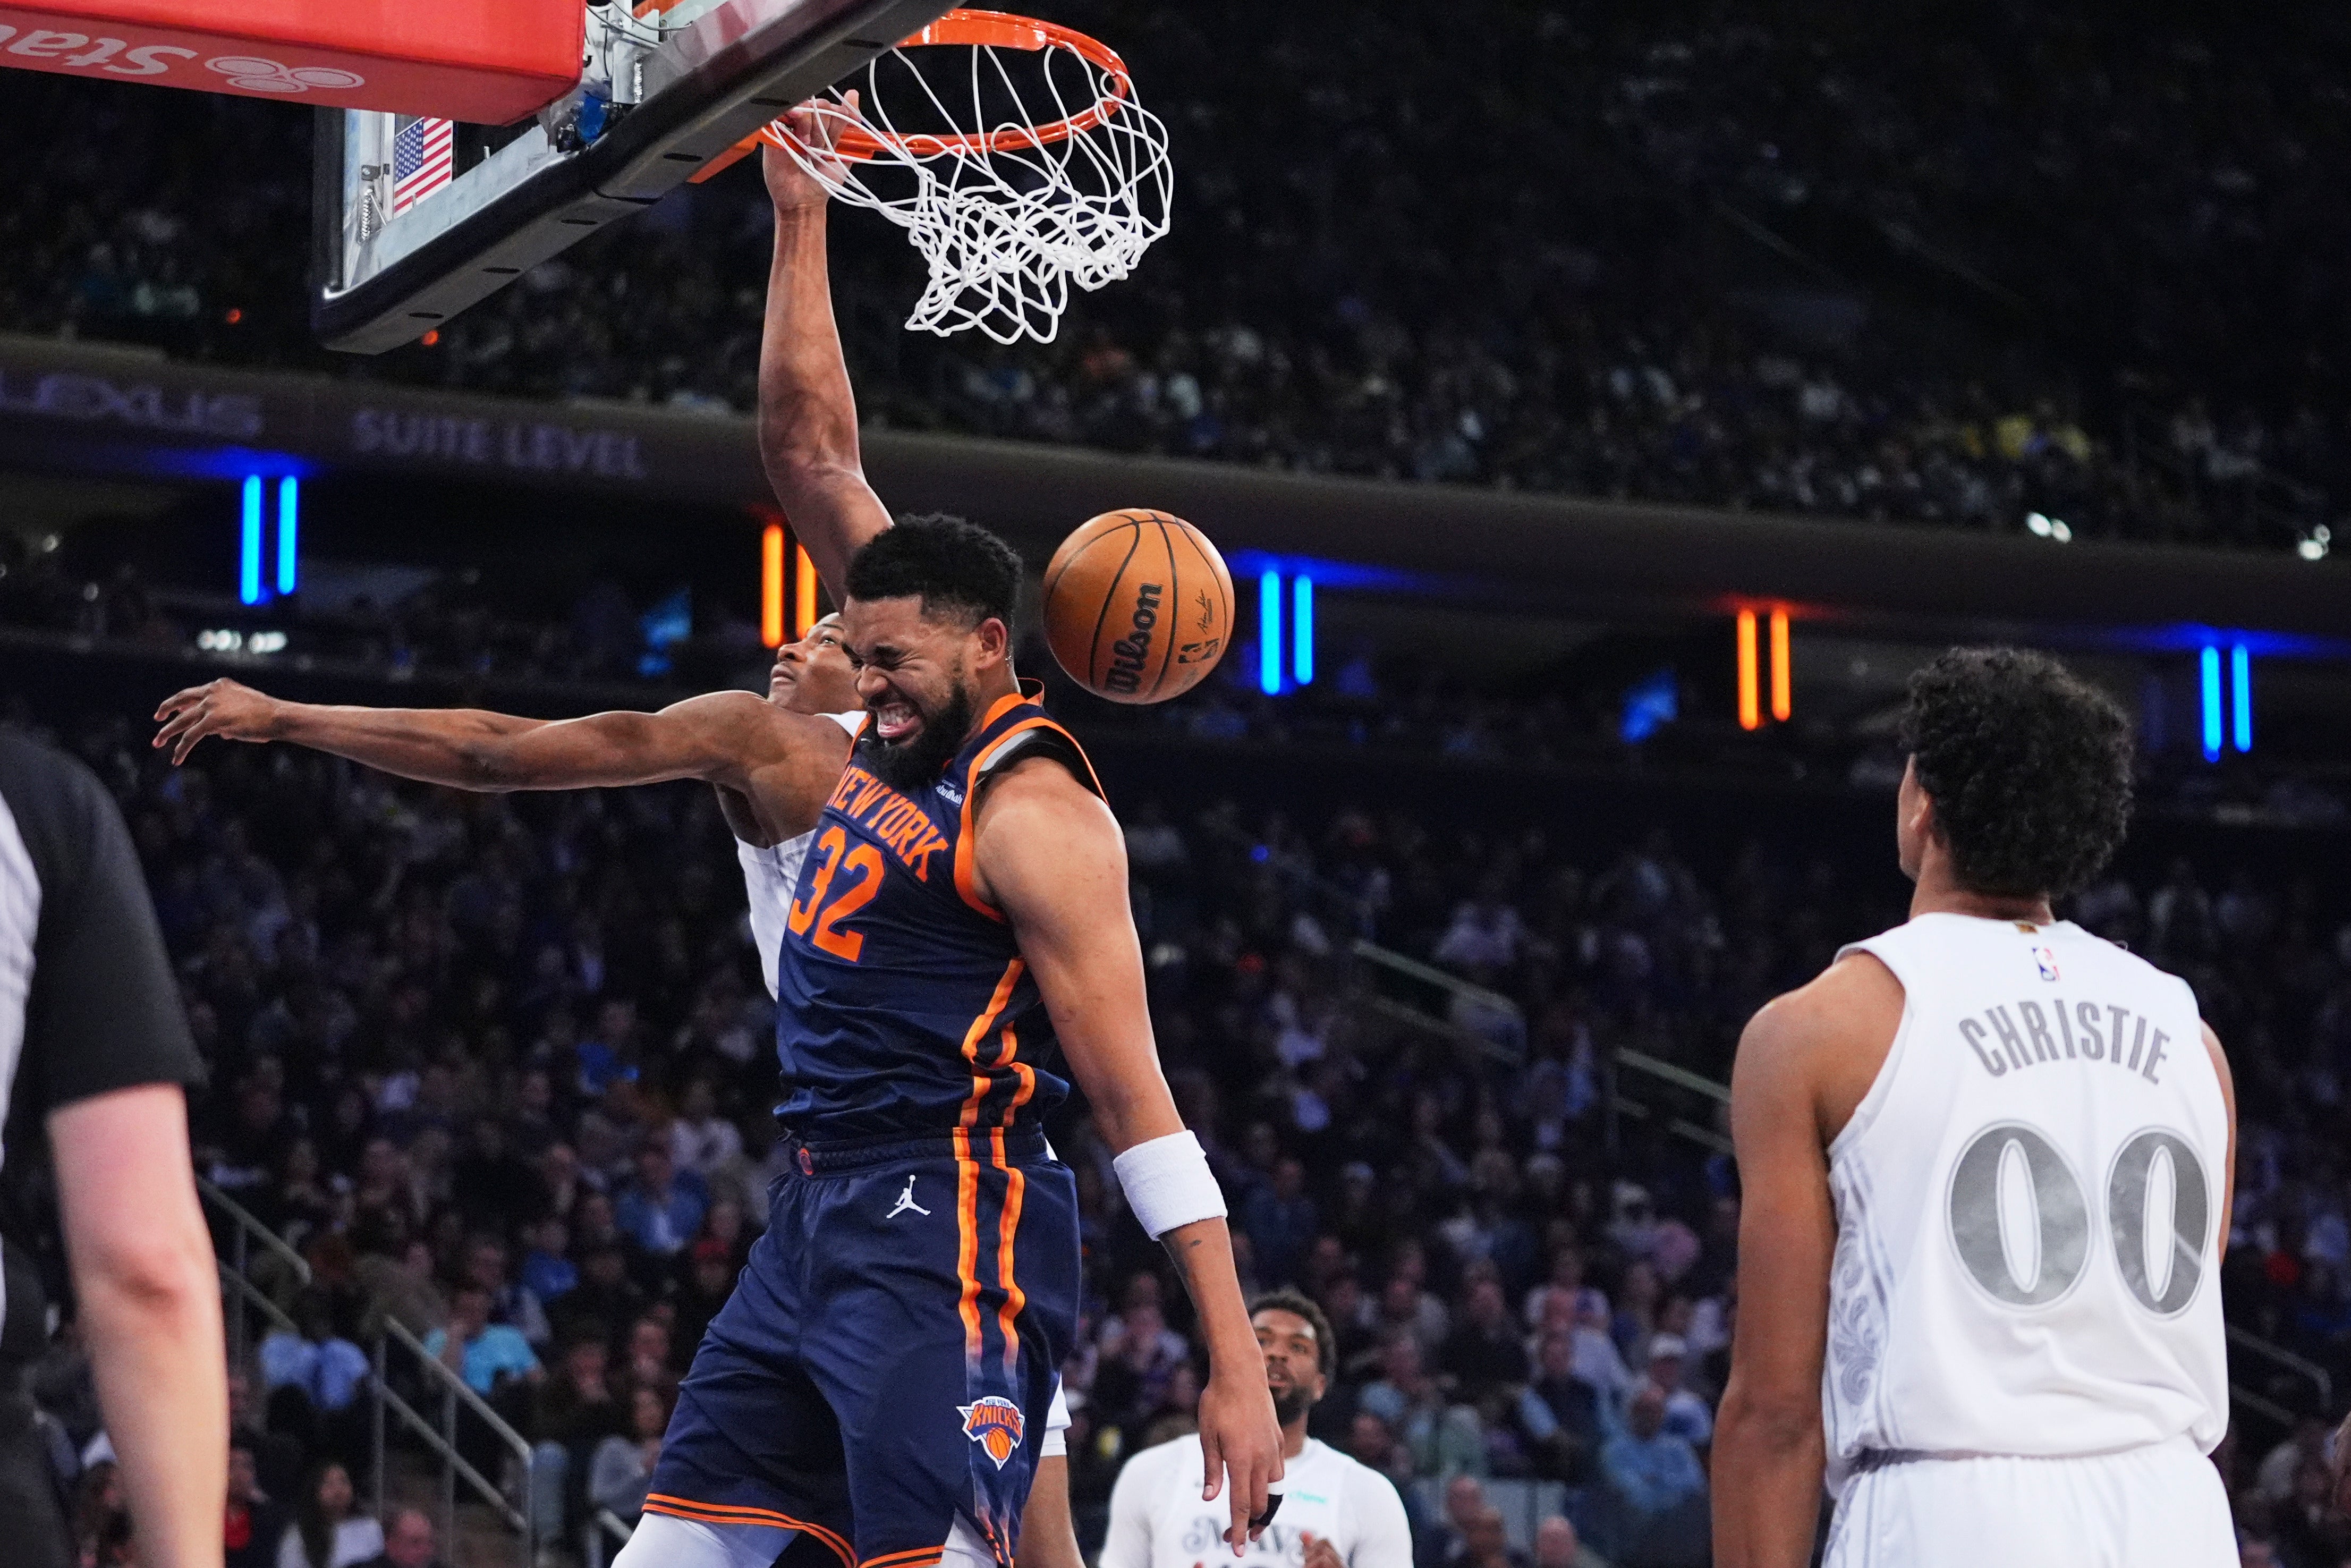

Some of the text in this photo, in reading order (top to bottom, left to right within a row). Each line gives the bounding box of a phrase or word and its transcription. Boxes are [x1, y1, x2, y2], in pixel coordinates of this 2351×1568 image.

[1105, 583, 1163, 694] Wilson
[826, 766, 949, 883] NEW YORK
[788, 825, 885, 962] 32
[1959, 999, 2171, 1084] CHRISTIE
[1943, 1119, 2212, 1321] 00
[966, 1403, 1021, 1438] KNICKS
